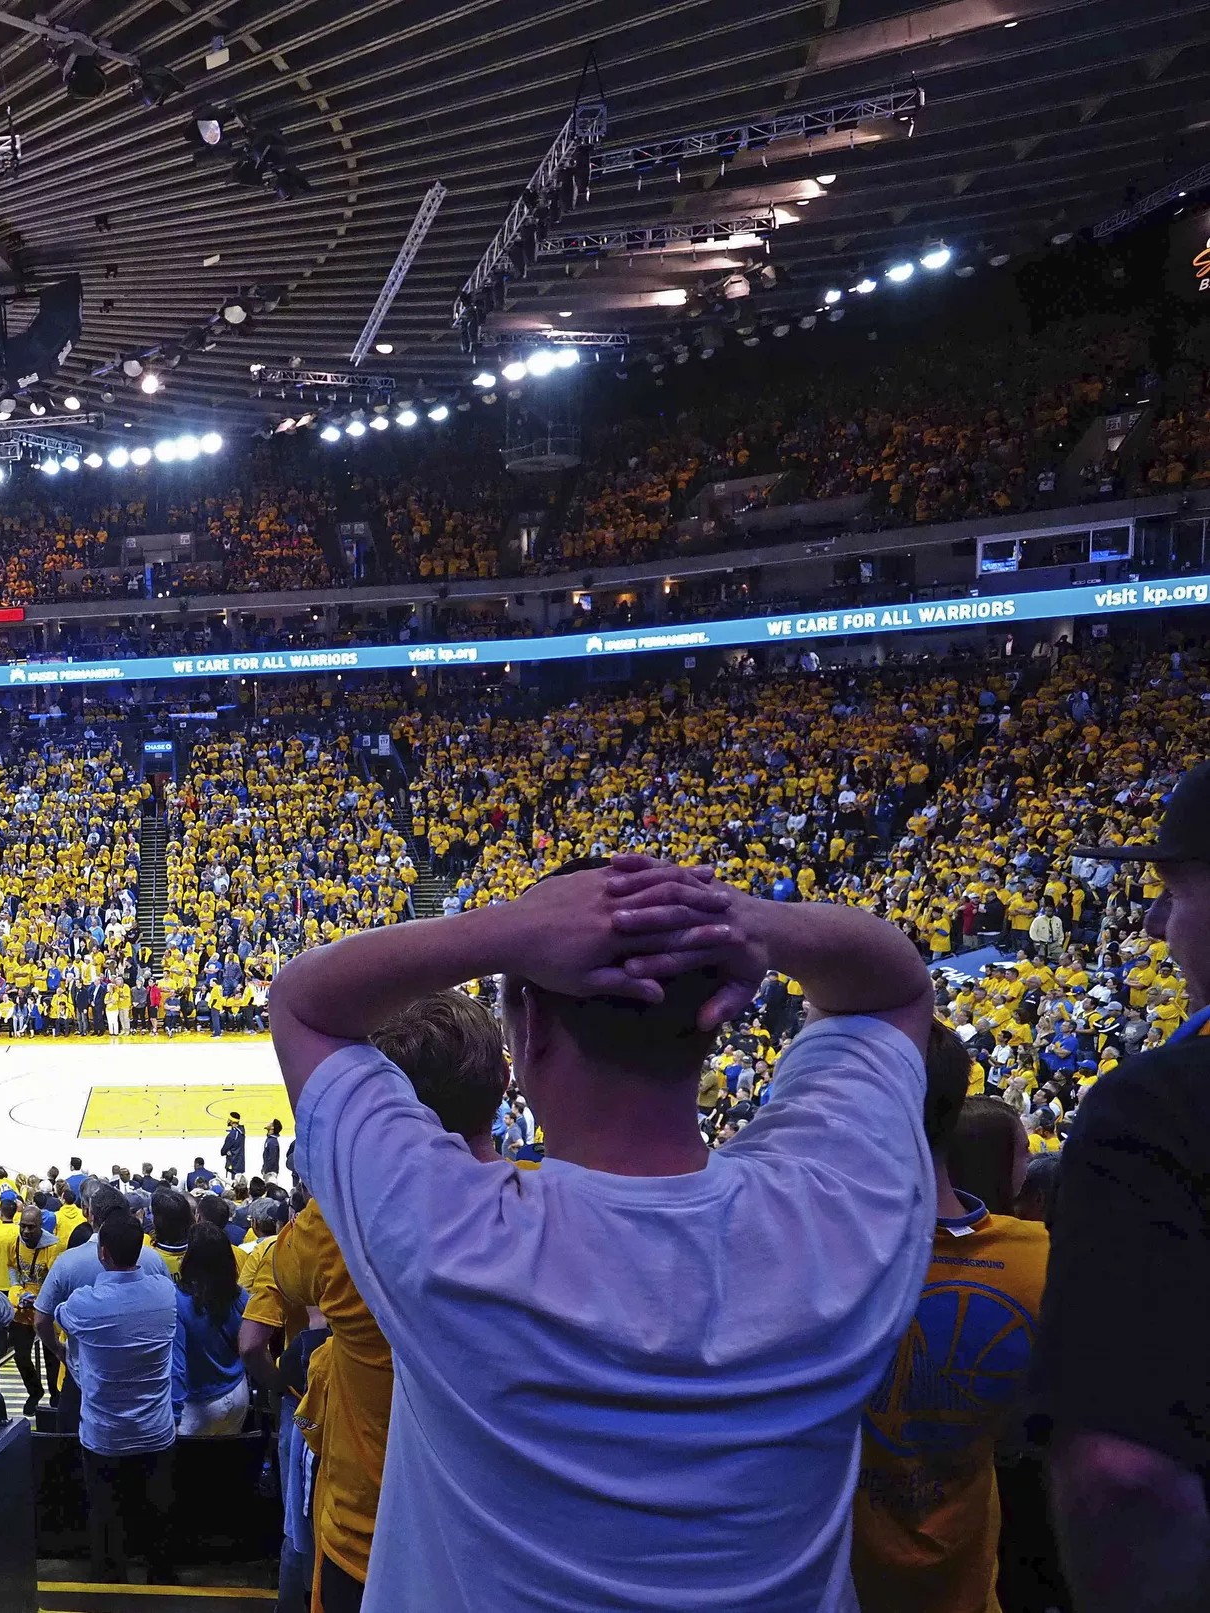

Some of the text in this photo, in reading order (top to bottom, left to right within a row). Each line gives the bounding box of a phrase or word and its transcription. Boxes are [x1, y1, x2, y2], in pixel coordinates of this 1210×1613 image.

[1094, 584, 1208, 607] visit kp.org
[766, 600, 1016, 636] WE CARE FOR ALL WARRIORS
[172, 652, 359, 673] WE CARE FOR ALL WARRIORS
[408, 647, 478, 663] visit kp.org
